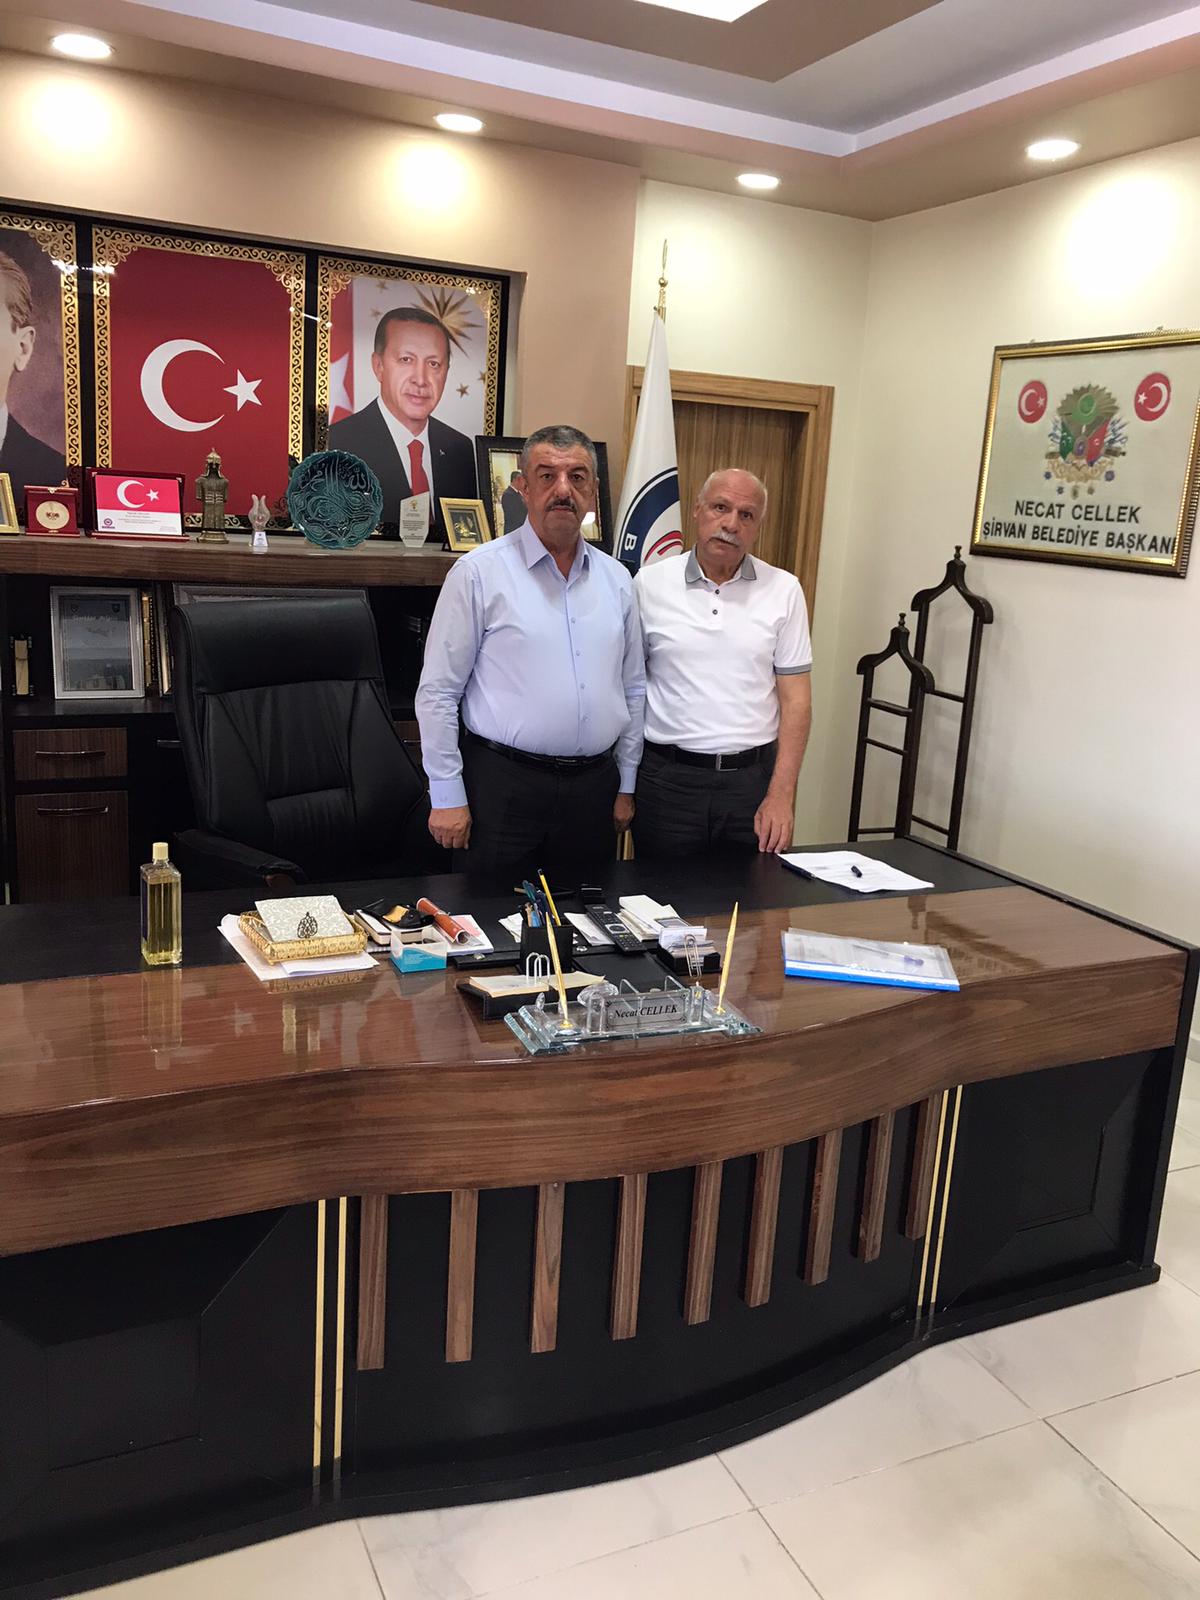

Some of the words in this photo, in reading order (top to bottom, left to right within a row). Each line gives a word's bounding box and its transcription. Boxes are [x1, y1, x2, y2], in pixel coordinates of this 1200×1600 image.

[1014, 500, 1065, 520] NECAT
[1071, 504, 1142, 524] CELLEK
[983, 516, 1027, 540] ŞİRVAN
[1031, 525, 1099, 547] BELEDİYE
[640, 1004, 678, 1016] CELLEK
